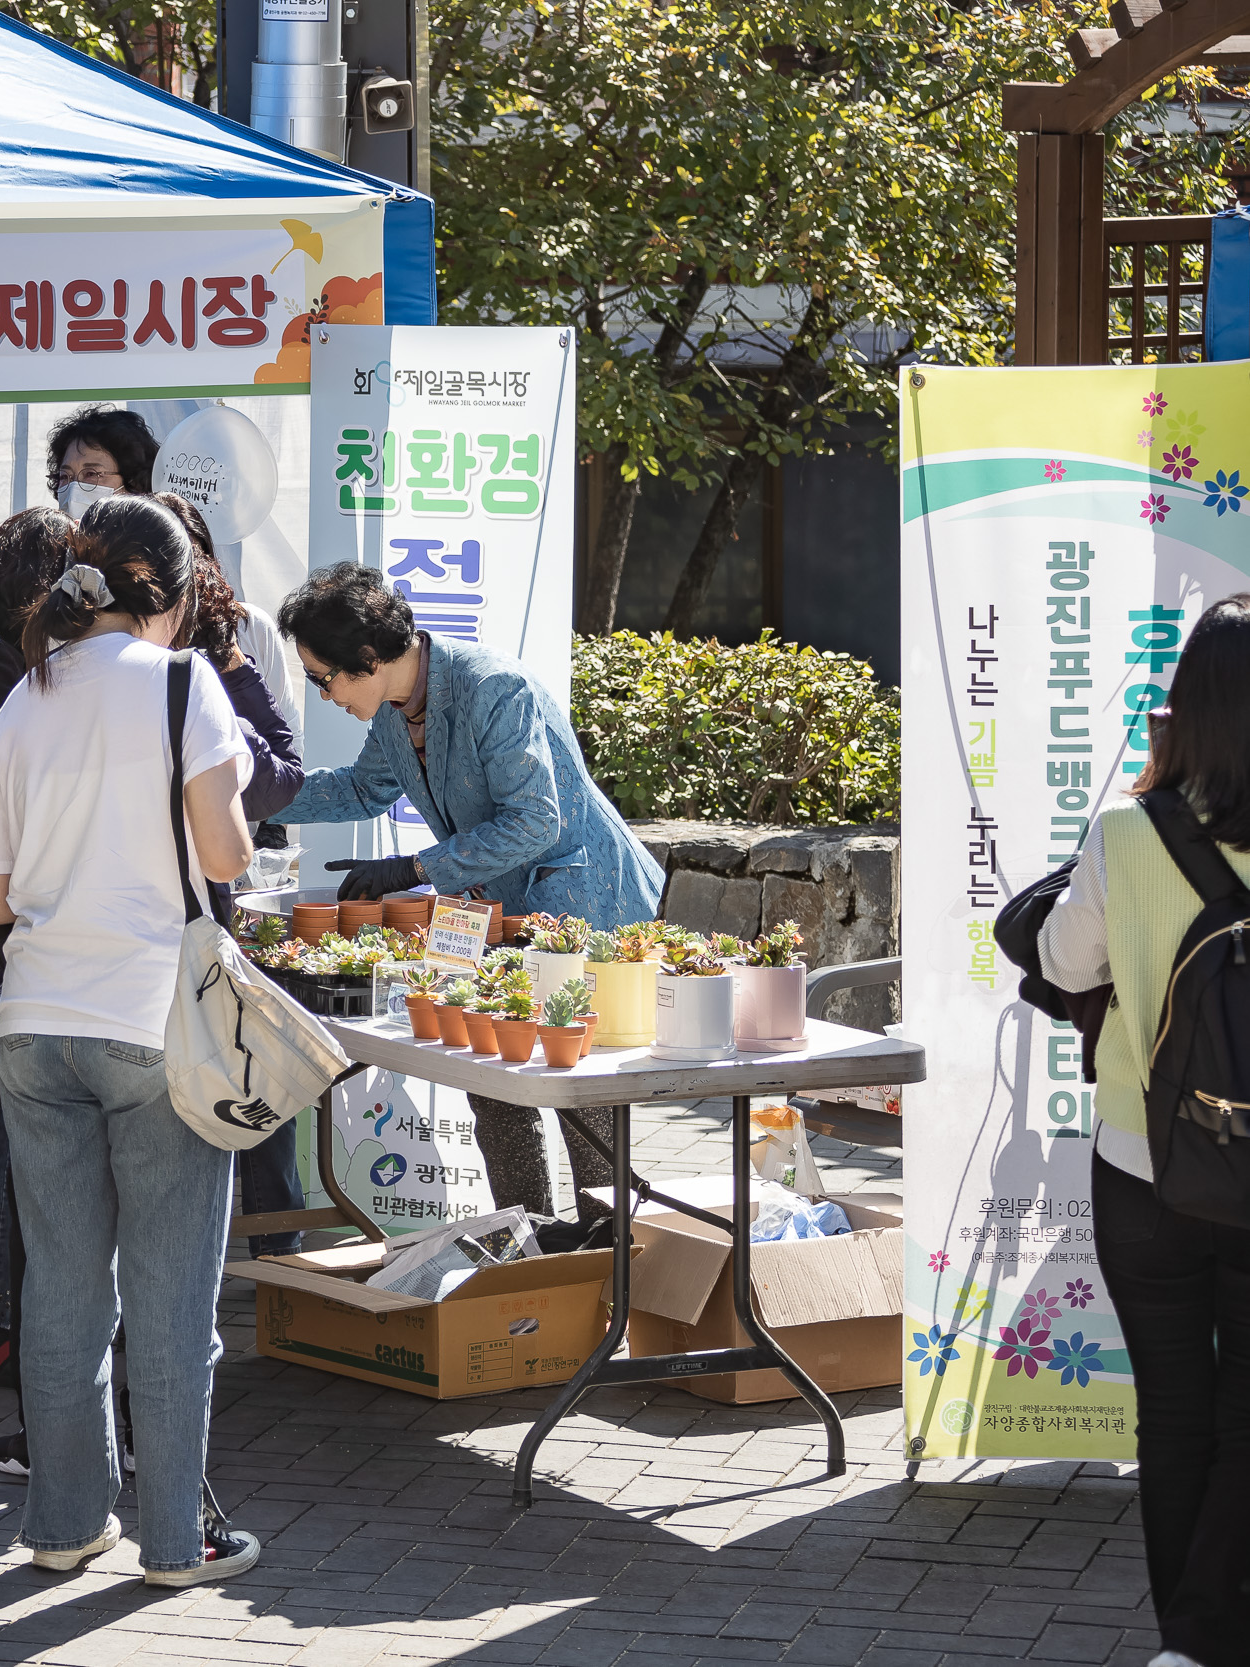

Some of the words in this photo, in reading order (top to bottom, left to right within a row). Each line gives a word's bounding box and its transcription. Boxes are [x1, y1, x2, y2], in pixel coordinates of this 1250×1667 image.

[334, 428, 541, 516] 친환경
[967, 604, 999, 706] 나누는
[967, 719, 999, 788] 기쁨
[967, 807, 999, 908] 누리는
[436, 942, 450, 952] 체험비
[452, 946, 472, 957] 2,000원
[967, 919, 999, 989] 행복
[236, 1097, 282, 1130] NIKE
[395, 1116, 473, 1146] 서울특별
[414, 1163, 482, 1187] 광진구
[372, 1195, 479, 1220] 민관협치사업
[978, 1197, 1053, 1219] 후원문의
[1067, 1200, 1092, 1217] 02
[958, 1226, 1072, 1244] 후원계좌:국민은행
[1075, 1229, 1093, 1242] 50
[971, 1251, 1100, 1265] (예금주:조계종사회복지재단
[374, 1343, 425, 1372] cactus
[671, 1362, 703, 1371] LIFETIME
[983, 1404, 1012, 1413] 광진구립
[983, 1415, 1127, 1435] 자양종합사회복지관
